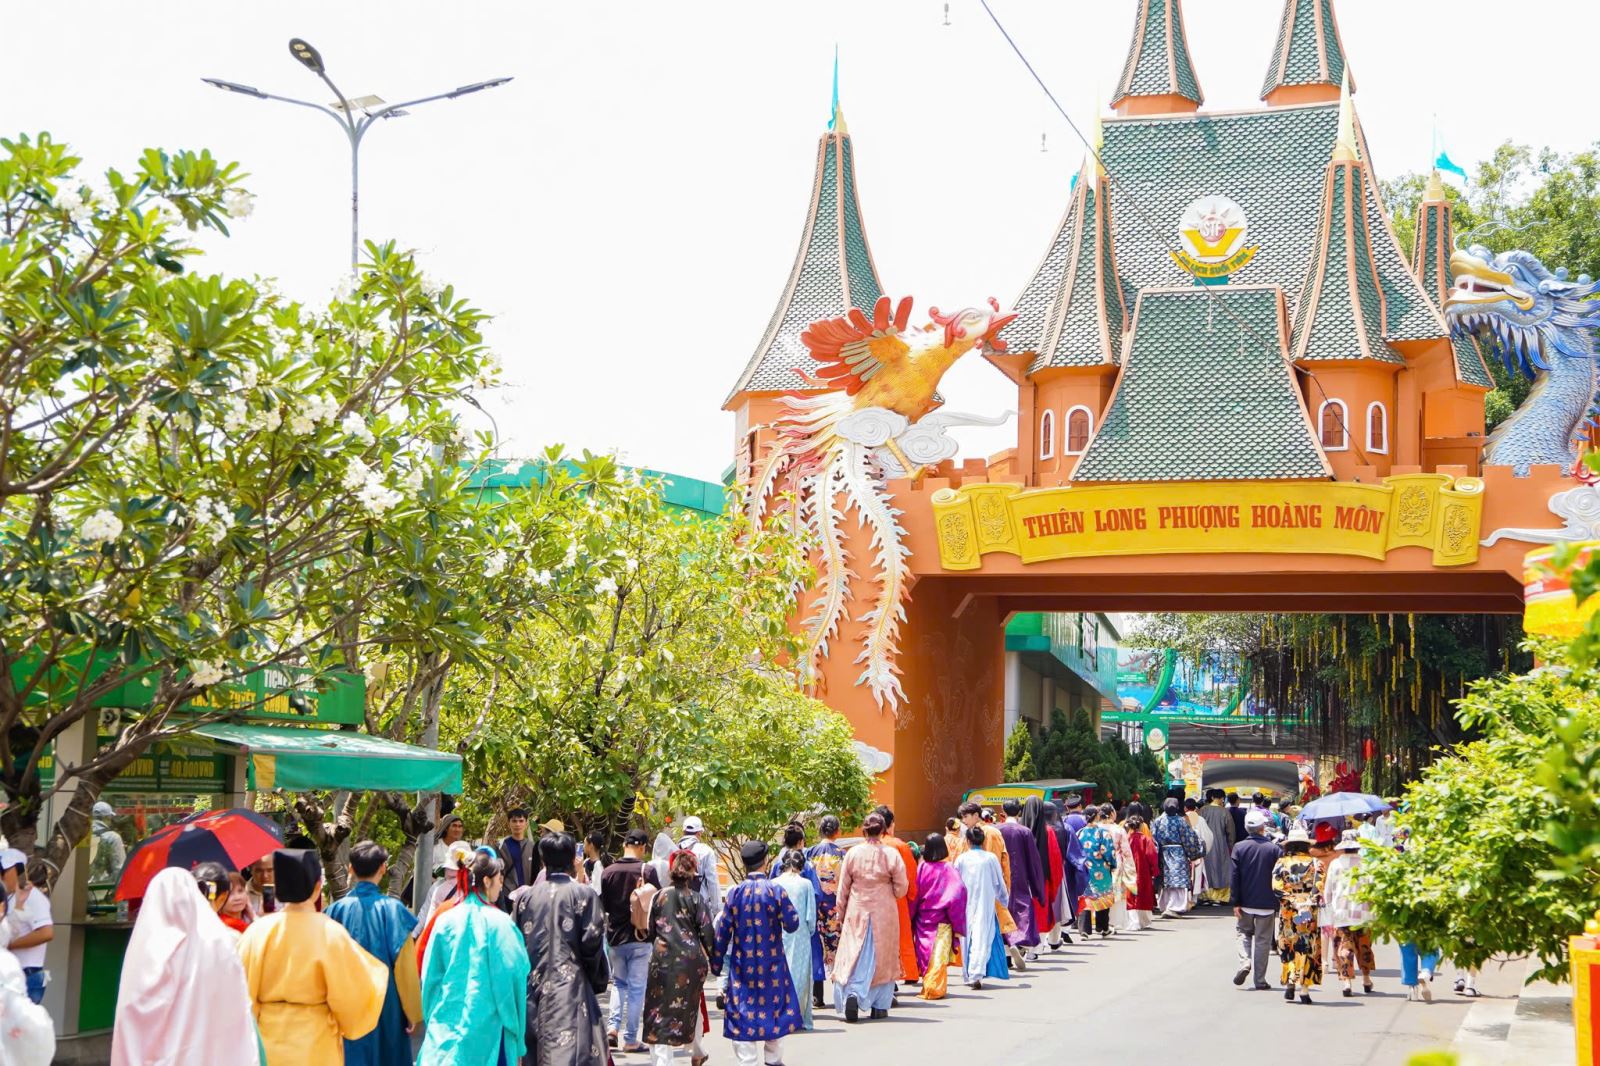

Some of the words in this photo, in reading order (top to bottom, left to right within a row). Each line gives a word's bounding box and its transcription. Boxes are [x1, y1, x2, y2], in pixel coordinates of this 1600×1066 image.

[1022, 507, 1085, 539] THIÊN
[1094, 507, 1147, 532] LONG
[1158, 504, 1240, 533] PHƯỢNG
[1251, 501, 1322, 528] HOÀNG
[1334, 504, 1385, 534] MÔN
